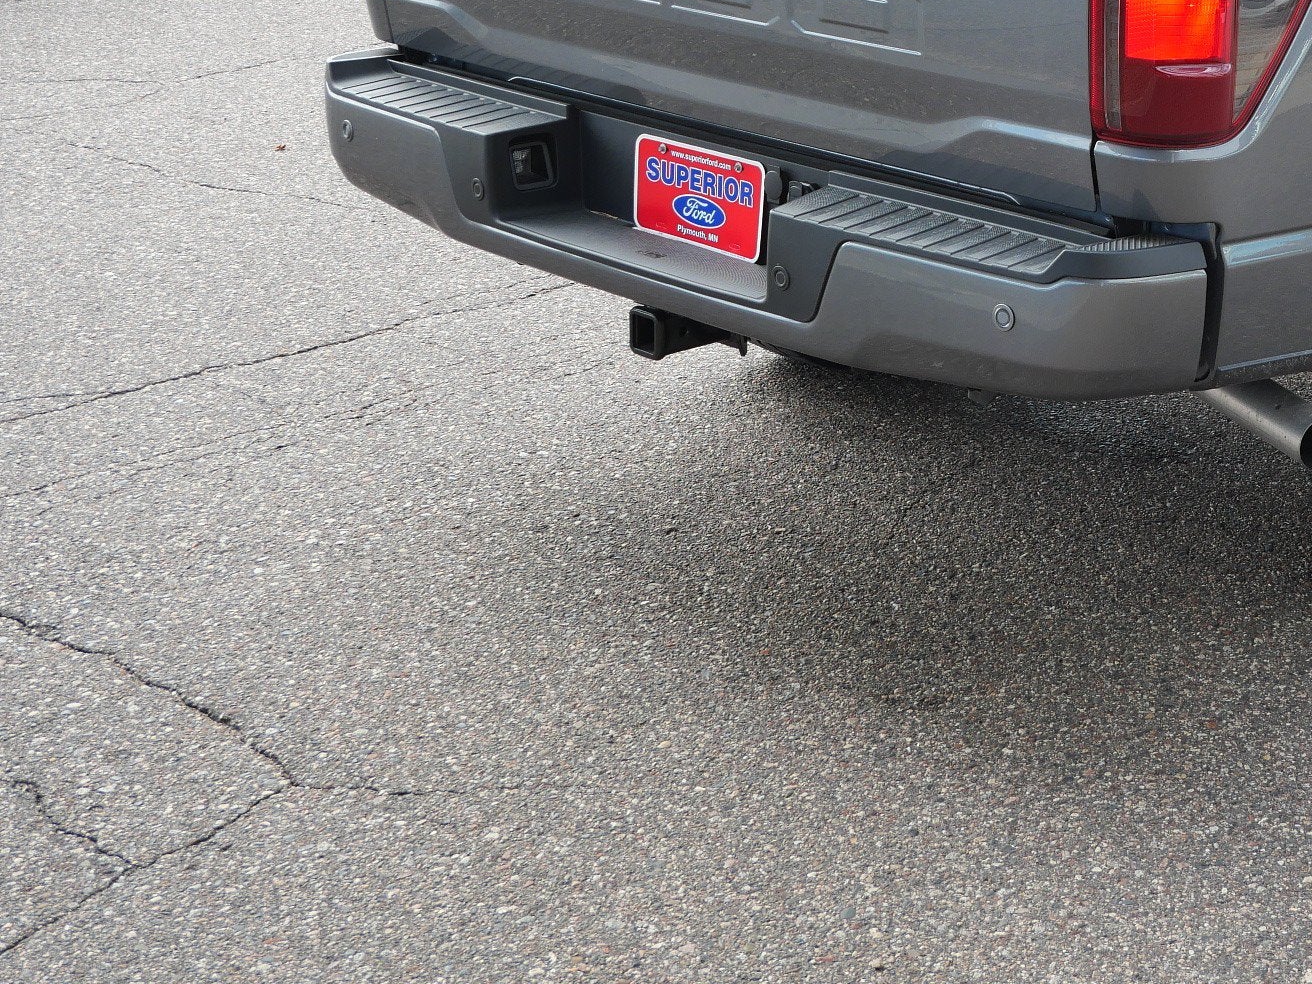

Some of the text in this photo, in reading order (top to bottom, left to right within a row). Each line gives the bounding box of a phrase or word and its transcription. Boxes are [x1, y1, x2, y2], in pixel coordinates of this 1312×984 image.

[671, 149, 731, 171] www.superiorford.com
[646, 157, 754, 208] SUPERIOR
[683, 197, 716, 224] Ford
[677, 225, 718, 243] Plymouth, MN
